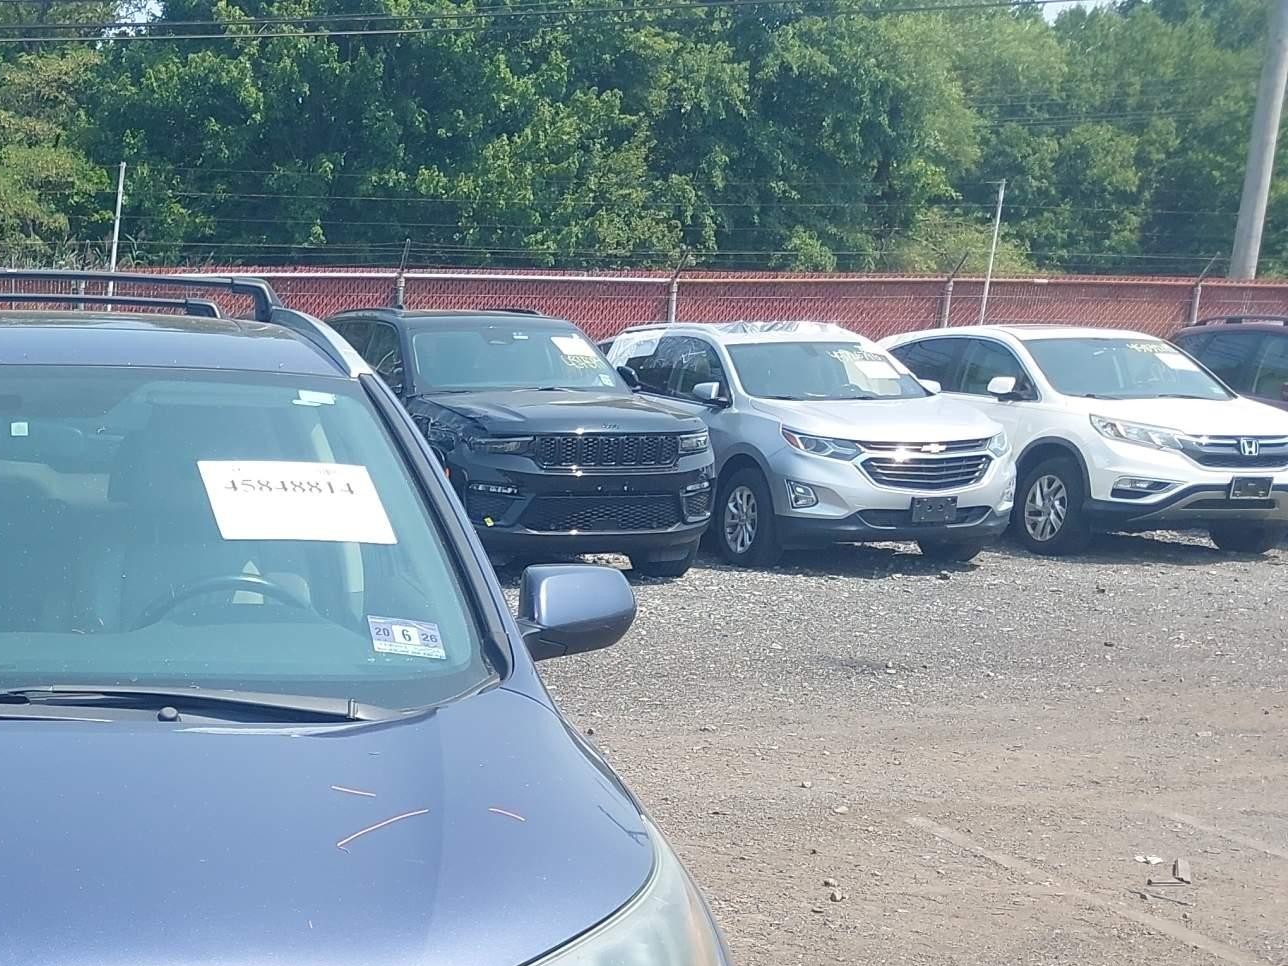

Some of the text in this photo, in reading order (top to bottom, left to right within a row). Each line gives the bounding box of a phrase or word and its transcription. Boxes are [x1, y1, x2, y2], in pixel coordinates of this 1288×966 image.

[224, 479, 354, 495] 45848814
[374, 626, 439, 643] 20 6 26
